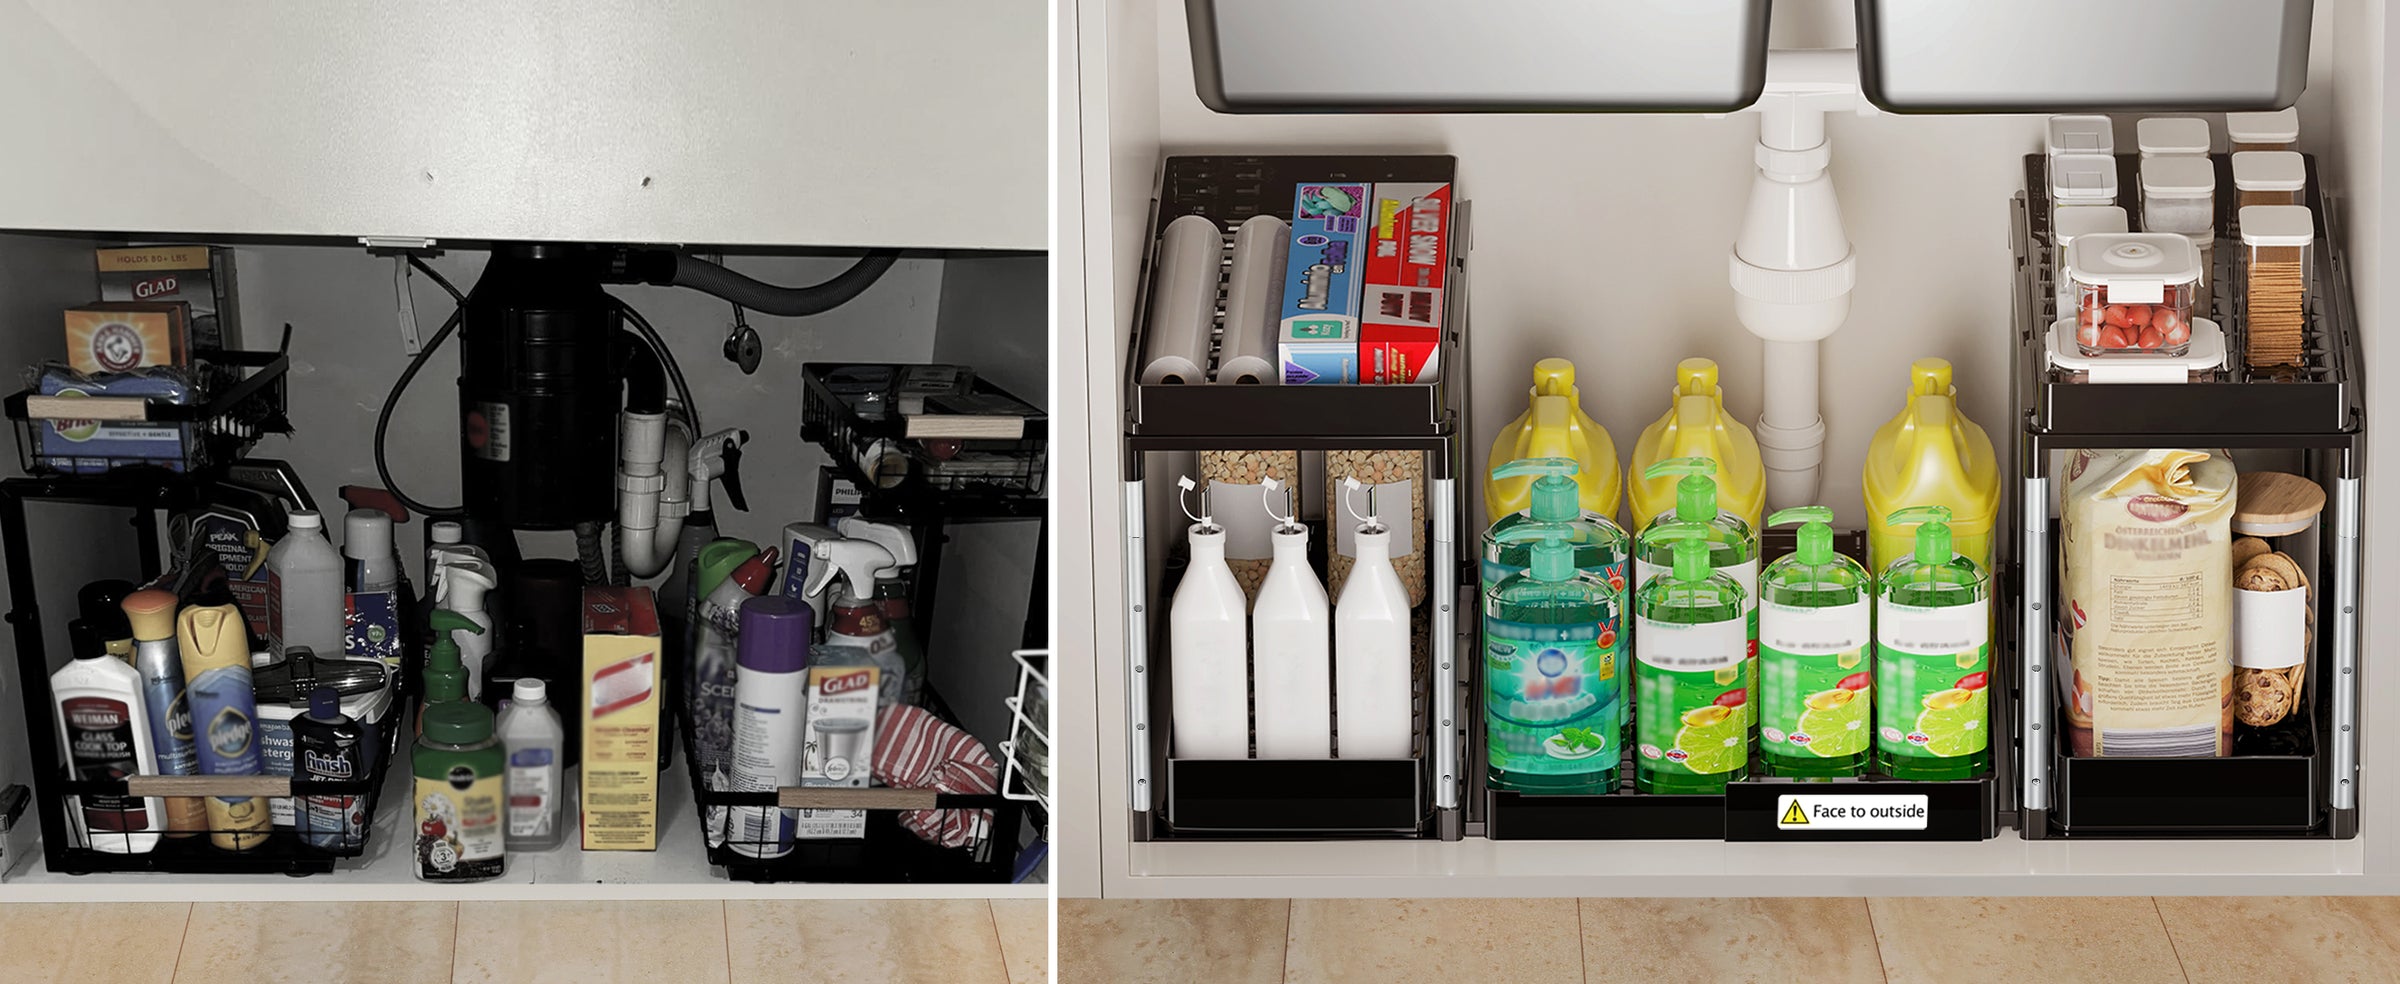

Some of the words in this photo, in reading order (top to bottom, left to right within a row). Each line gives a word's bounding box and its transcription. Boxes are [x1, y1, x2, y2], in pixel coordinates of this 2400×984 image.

[117, 254, 148, 263] HOLDS
[171, 253, 187, 262] LBS
[136, 278, 177, 297] GLAD
[210, 532, 239, 543] PEAK
[823, 674, 868, 693] GLAD
[72, 713, 119, 725] WEIMAN
[81, 731, 115, 742] GLASS
[106, 741, 127, 752] TOP
[305, 750, 352, 775] finish
[1813, 804, 1846, 818] Face
[1851, 806, 1866, 818] to
[1870, 803, 1925, 818] outside
